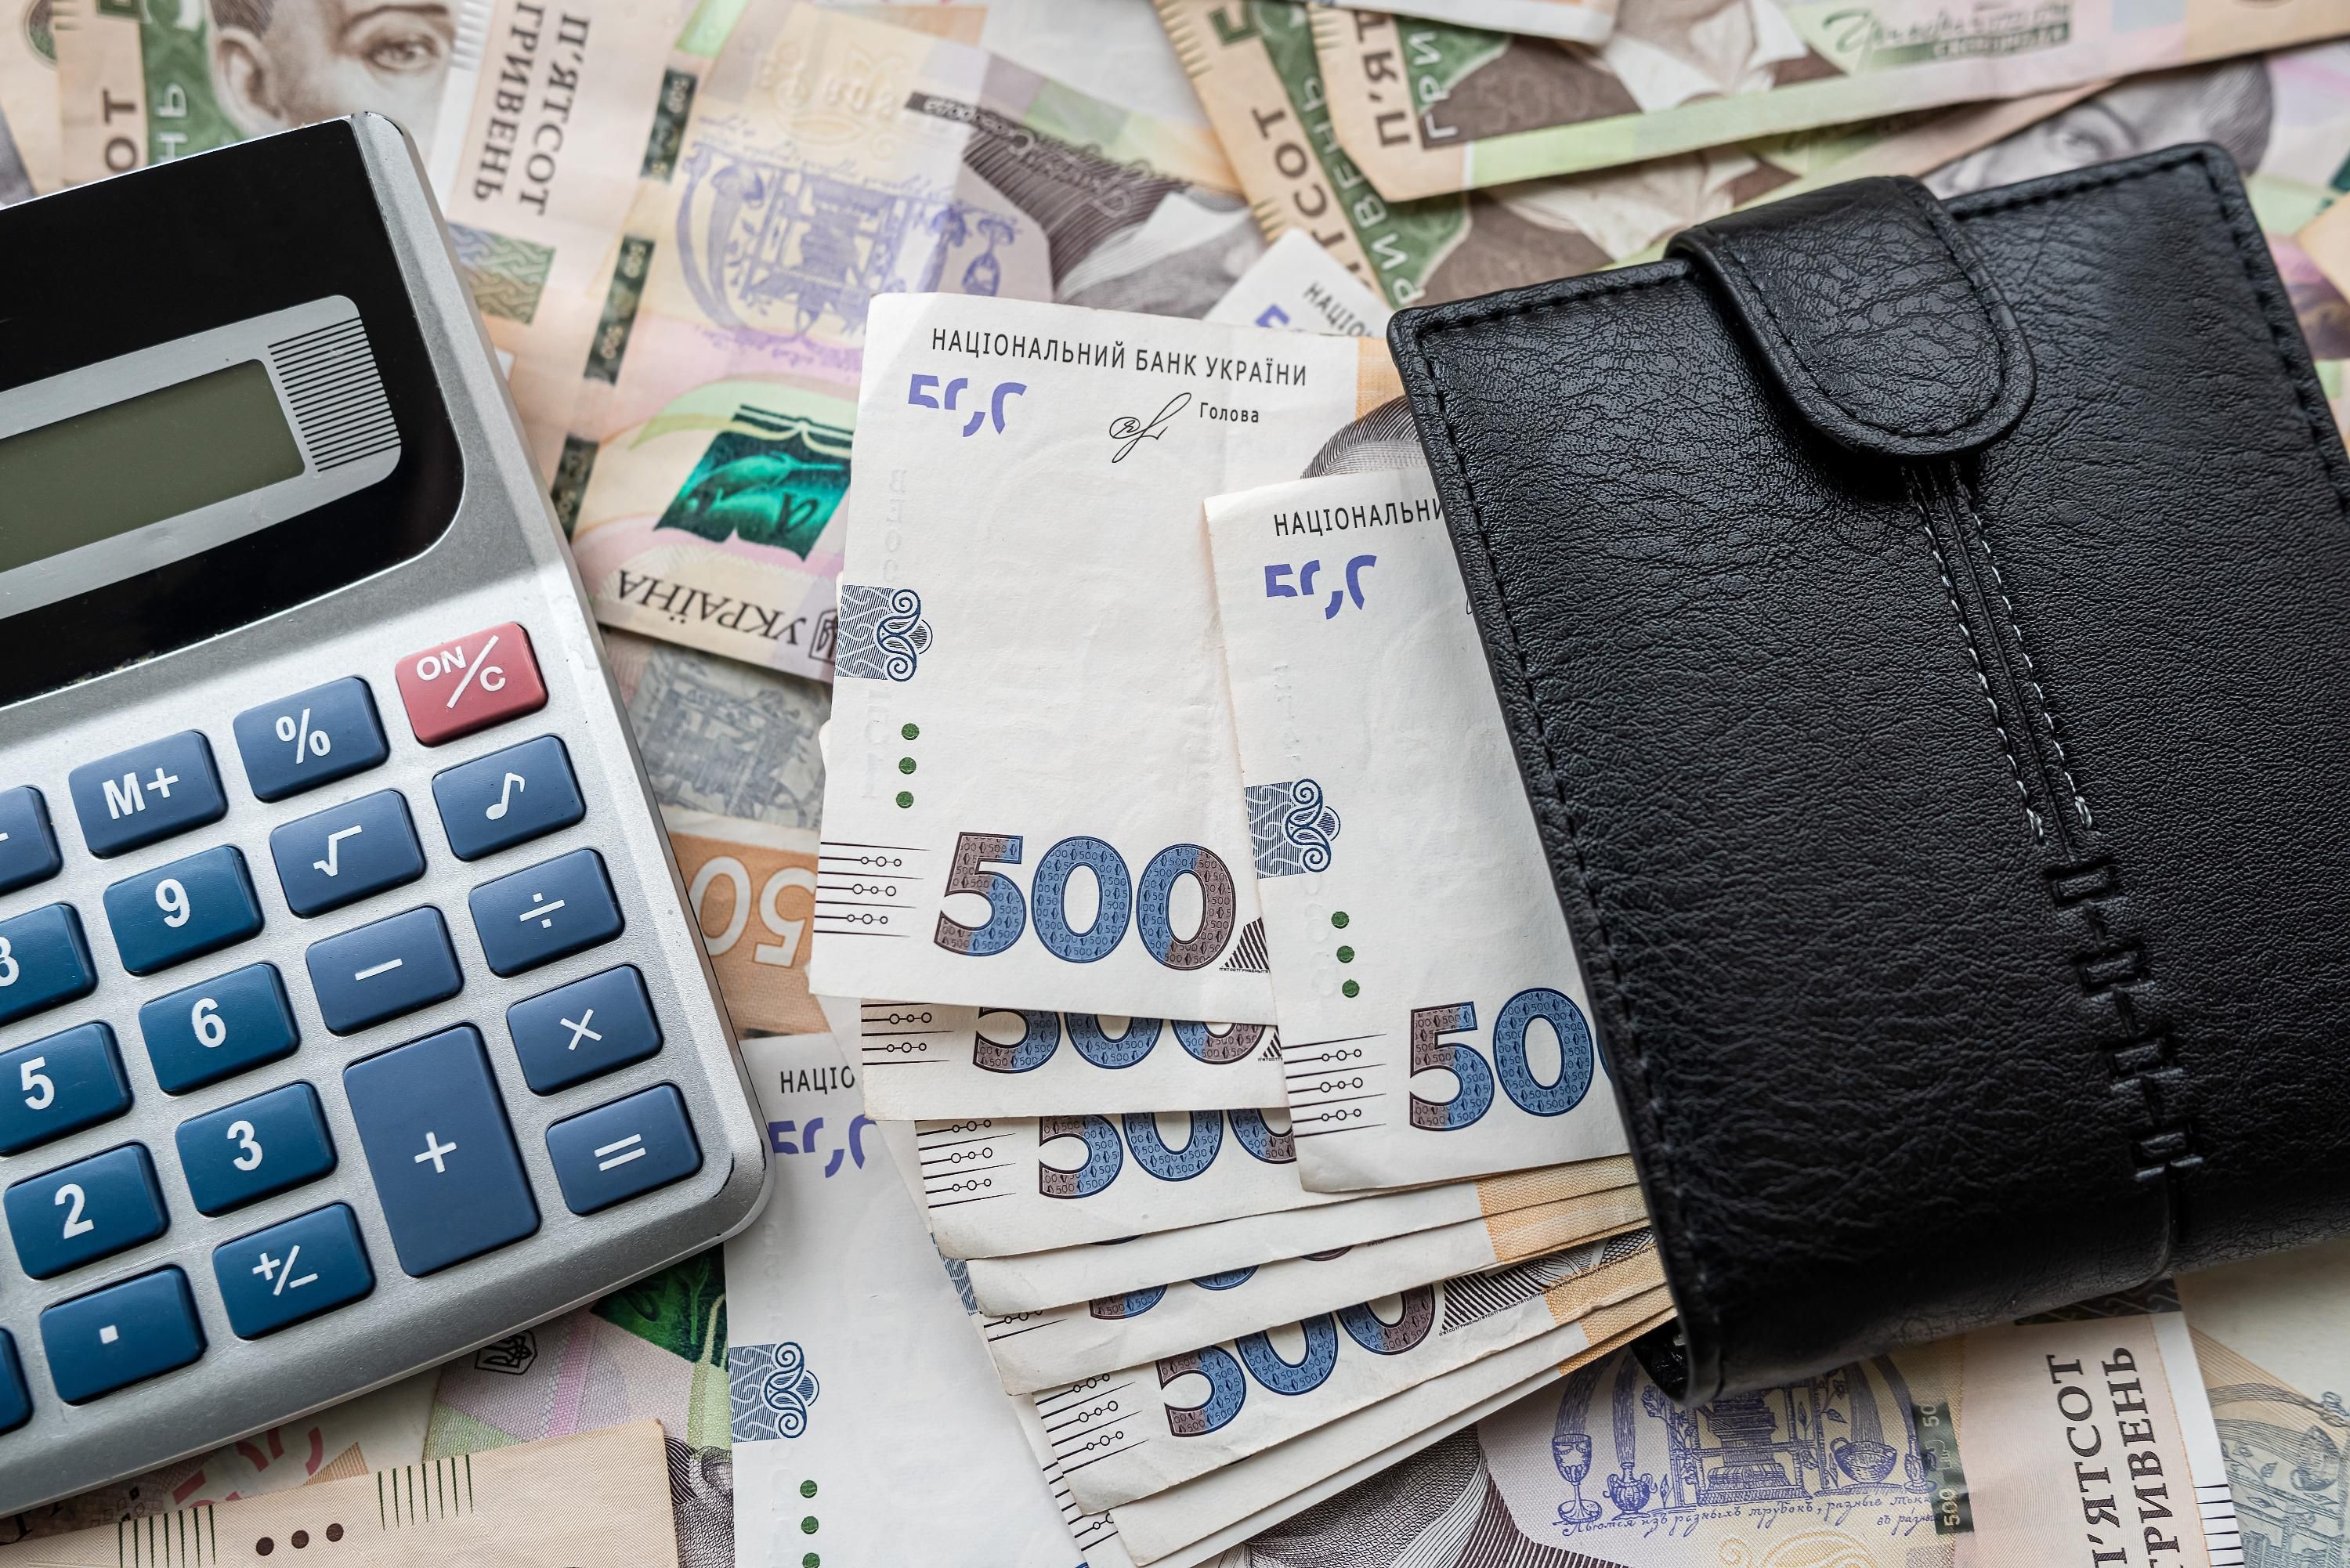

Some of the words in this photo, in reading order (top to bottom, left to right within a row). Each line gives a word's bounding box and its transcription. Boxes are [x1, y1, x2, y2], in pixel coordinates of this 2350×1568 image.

[932, 327, 1125, 369] НАЦІОНАЛЬНИЙ
[1136, 349, 1197, 377] БАНК
[1205, 356, 1307, 387] УКРАЇНИ
[1199, 402, 1260, 424] Голова
[618, 569, 807, 645] УКРАЇНА
[102, 767, 179, 821] M+
[155, 878, 191, 928] 9
[934, 832, 1236, 970] 500
[190, 998, 227, 1048] 6
[20, 1057, 55, 1110] 5
[1409, 987, 1614, 1132] 50
[226, 1120, 263, 1171] 3
[54, 1183, 94, 1239] 2
[2102, 1347, 2184, 1568] РИВЕНЬ
[1938, 1487, 1961, 1527] 500
